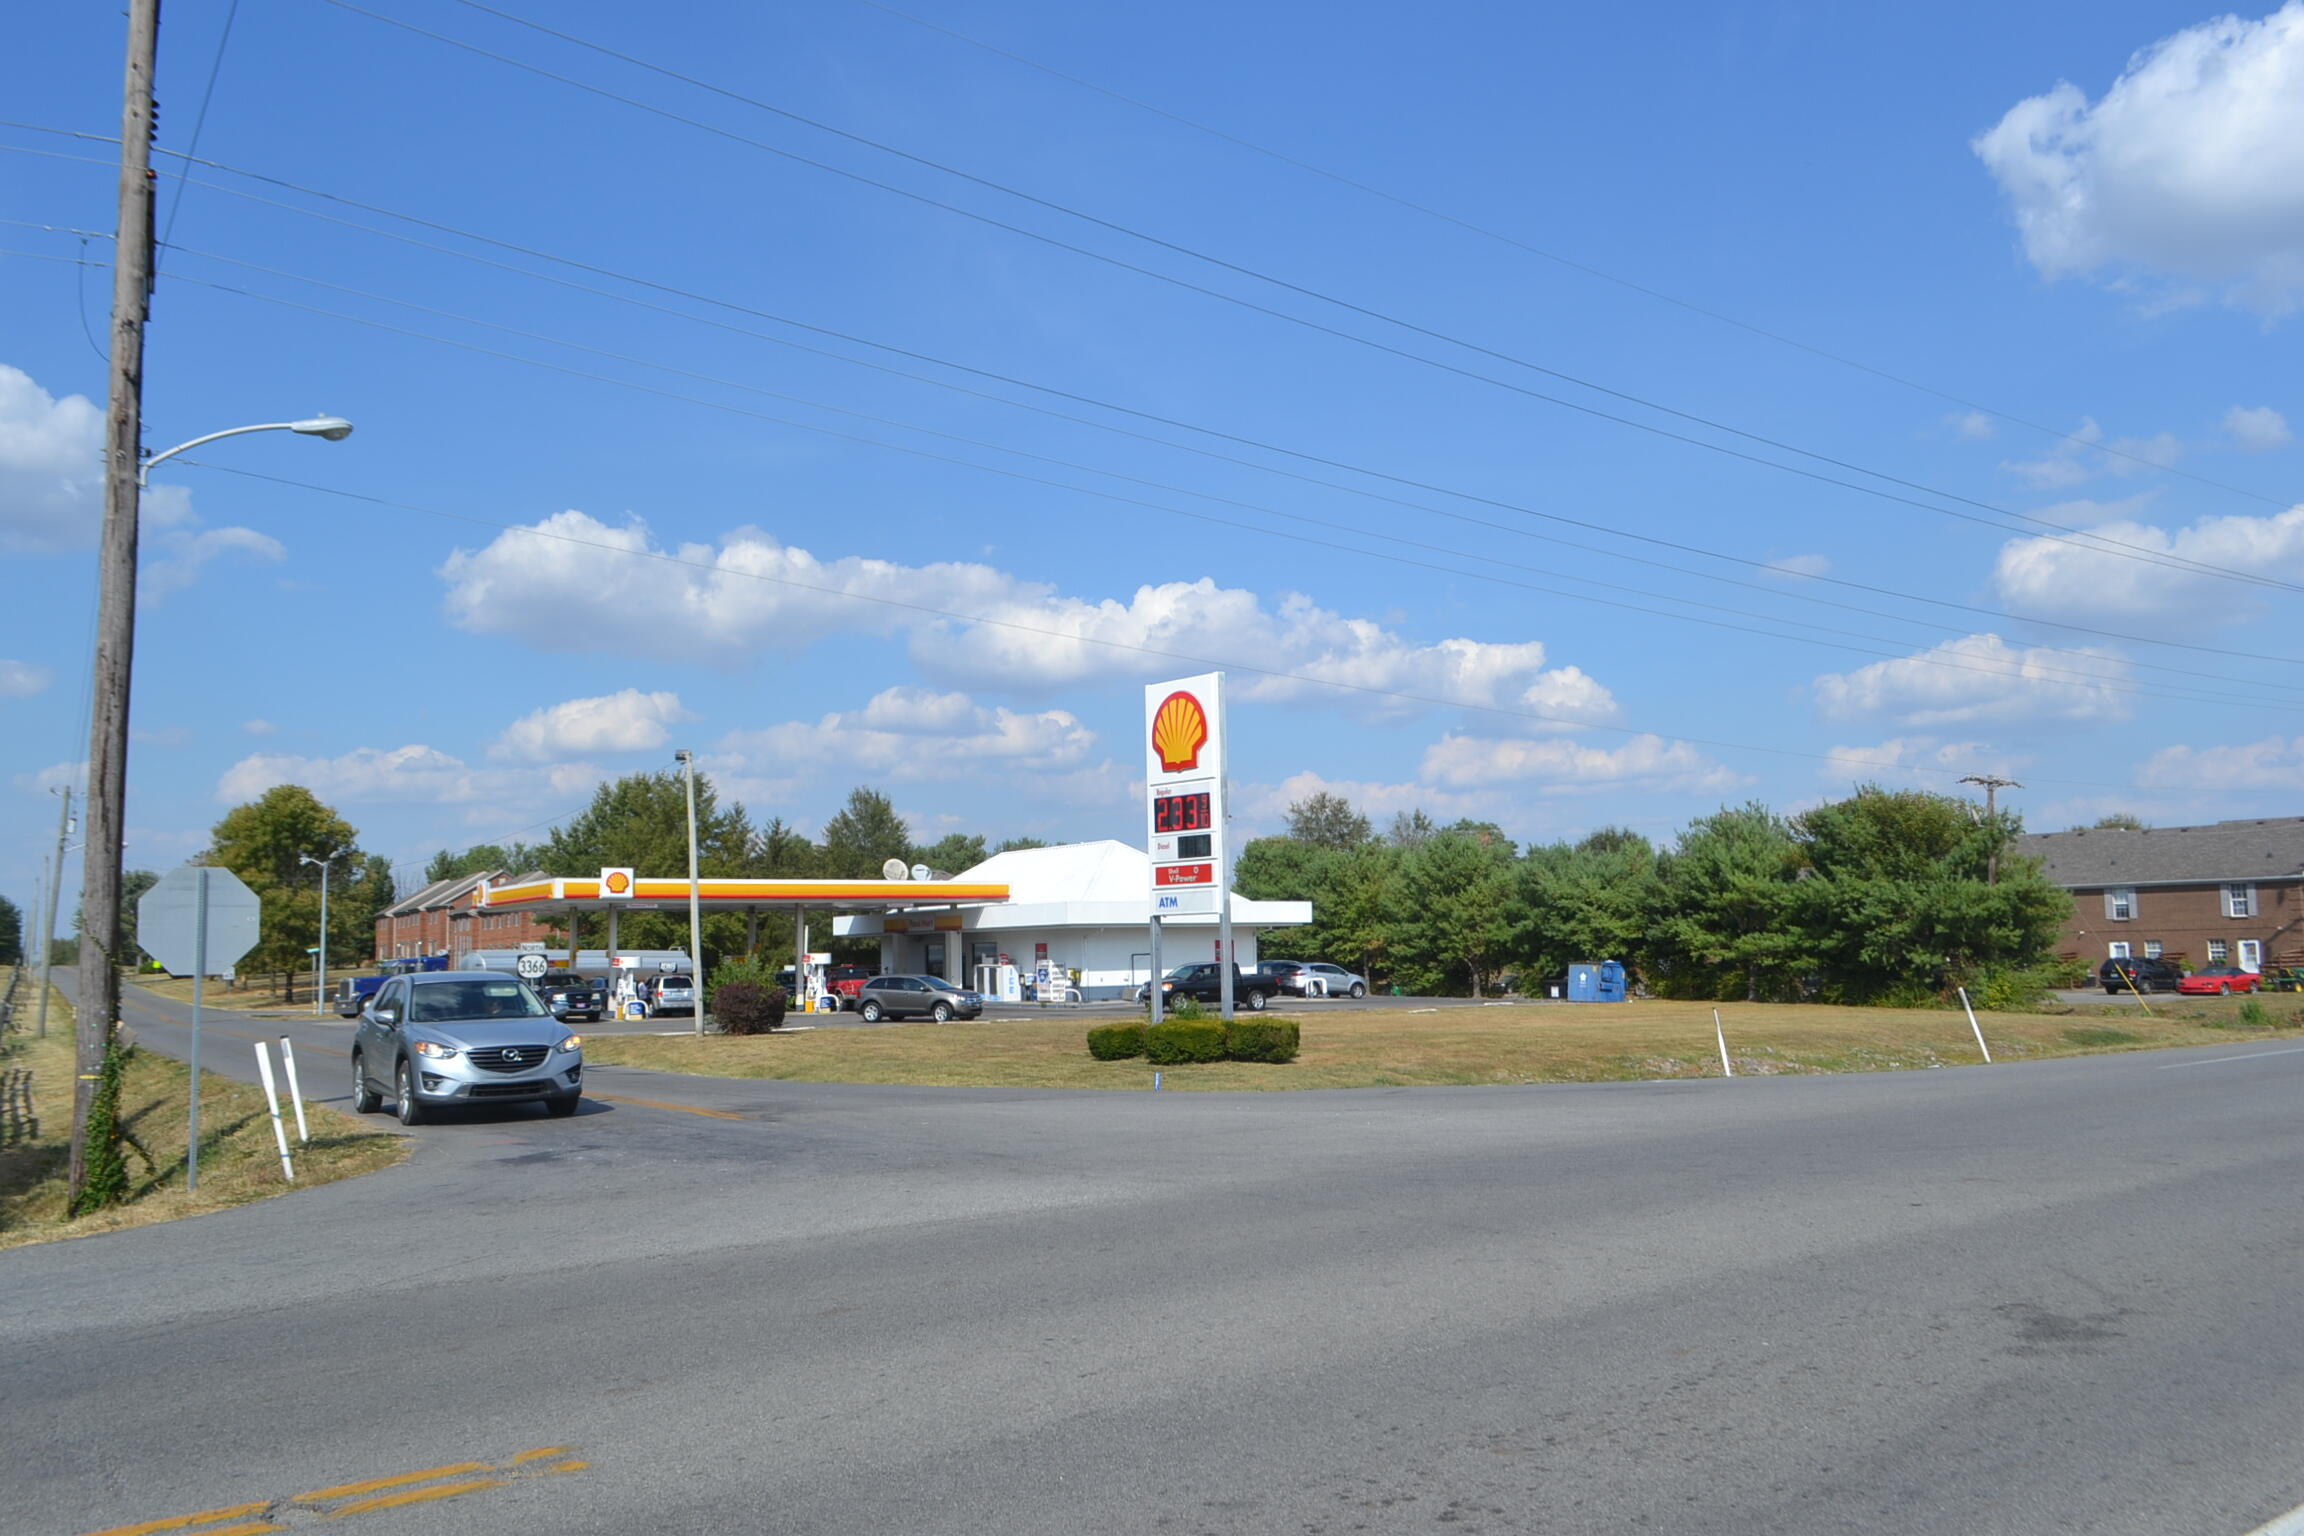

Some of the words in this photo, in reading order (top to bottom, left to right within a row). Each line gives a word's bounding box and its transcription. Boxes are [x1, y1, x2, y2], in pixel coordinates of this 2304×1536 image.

[1169, 874, 1197, 883] V-Power
[1159, 896, 1178, 908] ATM
[522, 944, 543, 952] NORTH
[520, 960, 545, 973] 3366
